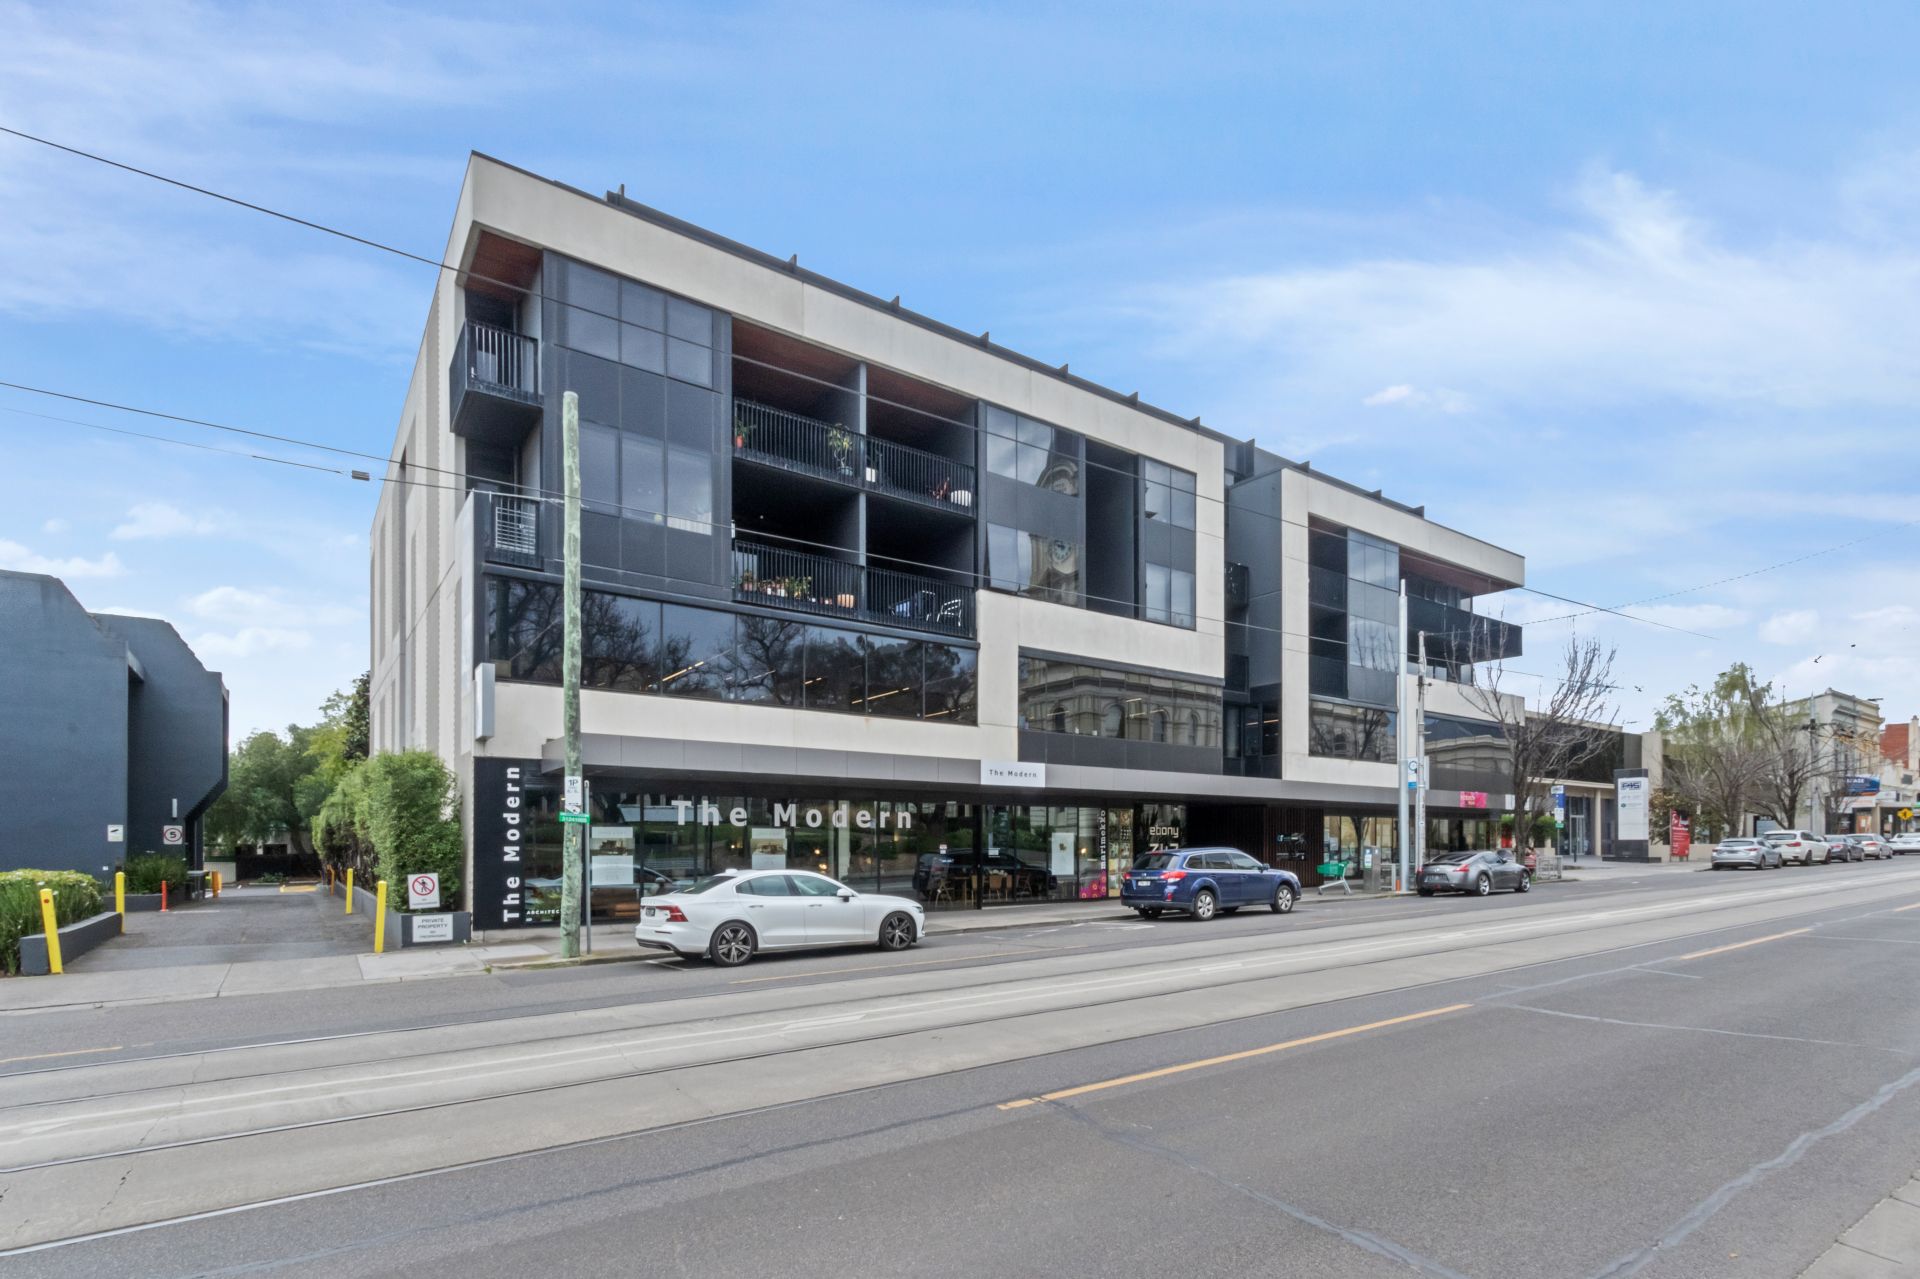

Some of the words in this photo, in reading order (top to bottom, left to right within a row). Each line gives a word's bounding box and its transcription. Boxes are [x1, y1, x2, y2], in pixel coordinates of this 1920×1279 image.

[989, 769, 1004, 777] The
[1008, 770, 1037, 778] Modern
[503, 766, 520, 862] Modern
[670, 800, 748, 827] The
[773, 803, 912, 829] Modern
[1149, 825, 1179, 839] ebony
[503, 876, 520, 922] The
